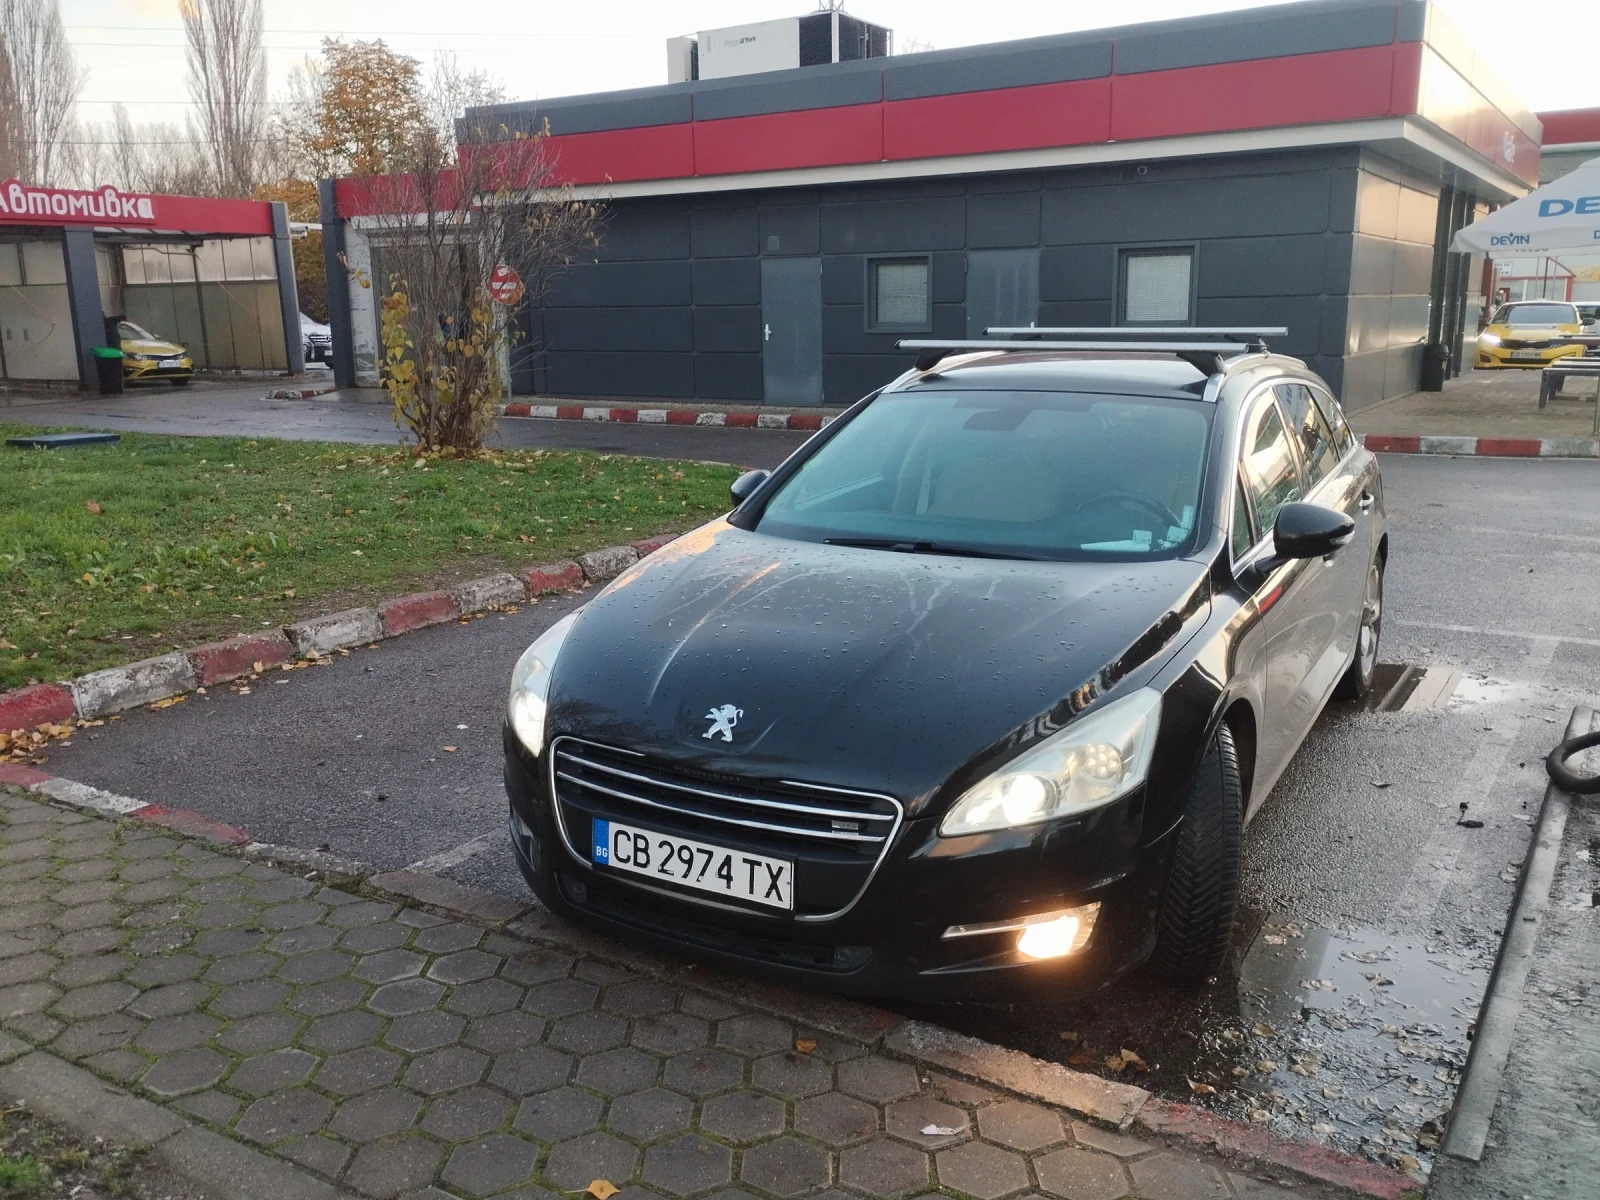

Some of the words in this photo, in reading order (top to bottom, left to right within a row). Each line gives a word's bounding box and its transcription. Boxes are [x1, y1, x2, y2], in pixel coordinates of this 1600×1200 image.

[1491, 233, 1530, 246] DEVIN
[596, 845, 608, 858] BG
[613, 829, 650, 869] CB
[657, 840, 734, 890] 2974
[742, 857, 784, 902] TX
